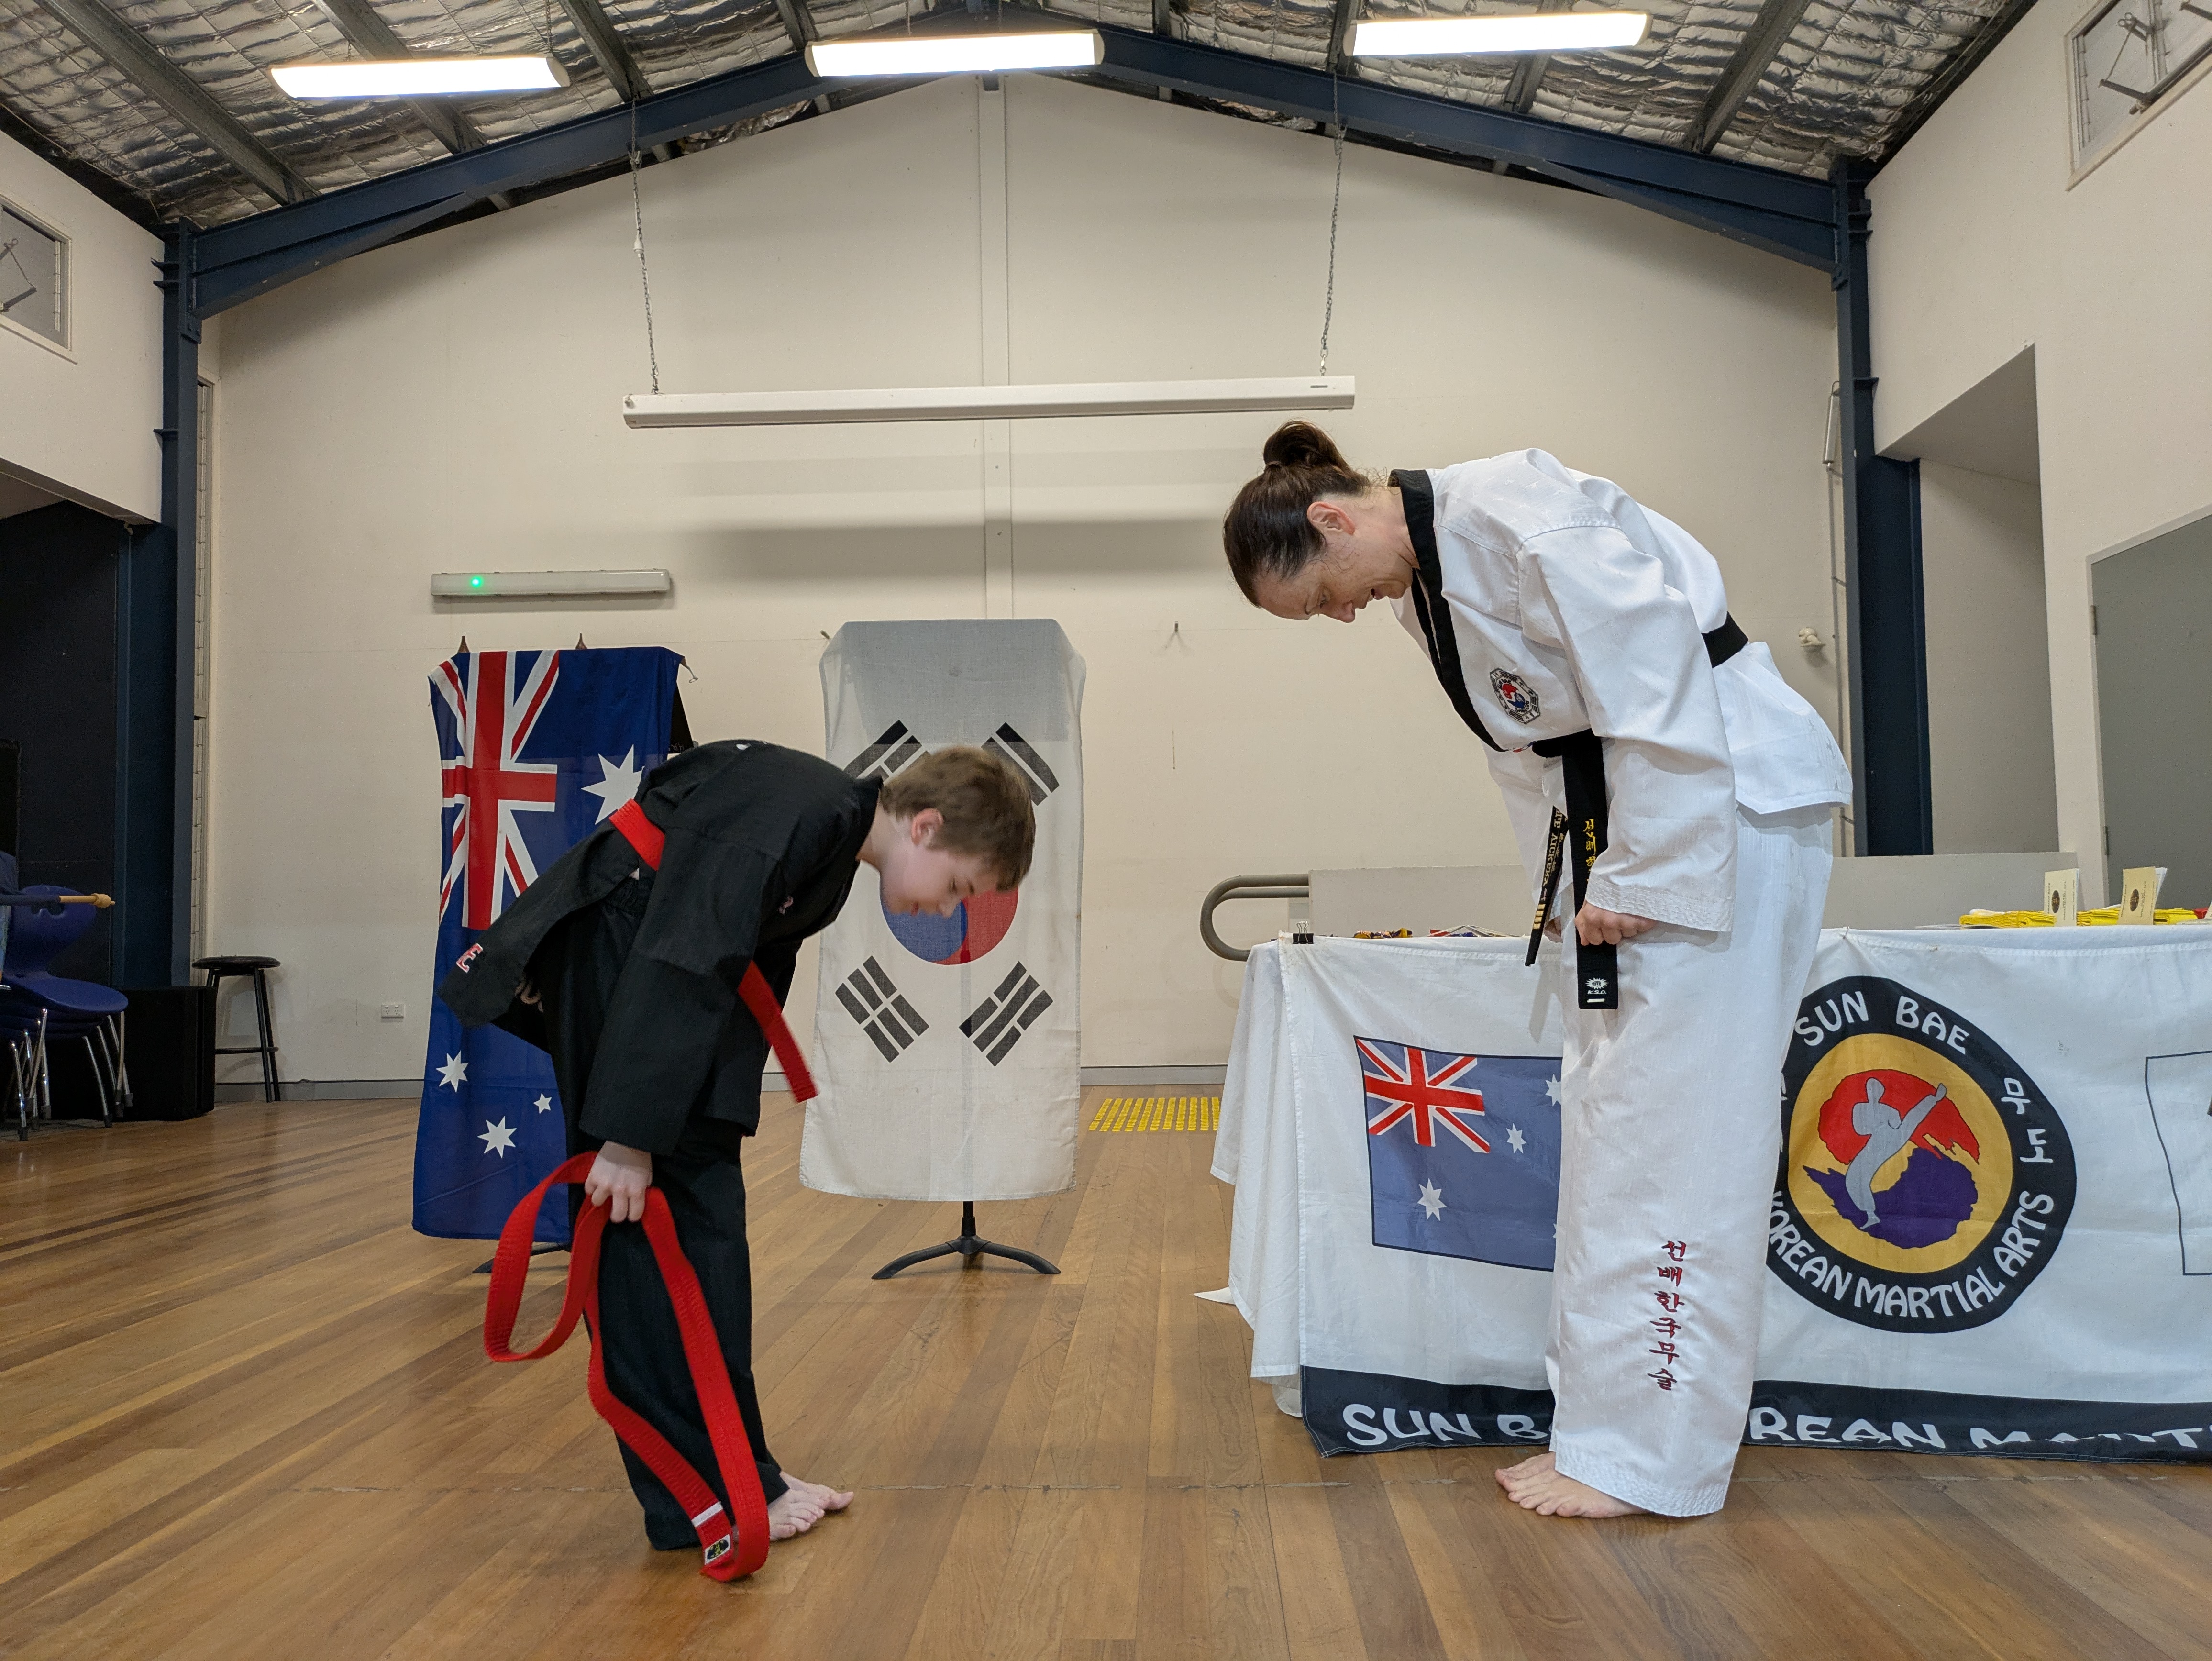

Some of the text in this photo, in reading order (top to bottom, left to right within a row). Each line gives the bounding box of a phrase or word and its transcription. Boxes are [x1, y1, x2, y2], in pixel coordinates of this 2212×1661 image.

[456, 942, 484, 973] E
[1794, 991, 1969, 1054] SUN BAE
[1855, 1266, 2006, 1318] MARTIAL
[1994, 1190, 2054, 1278] ARTS
[1342, 1403, 1482, 1446] SUN
[1497, 1414, 1552, 1439] B
